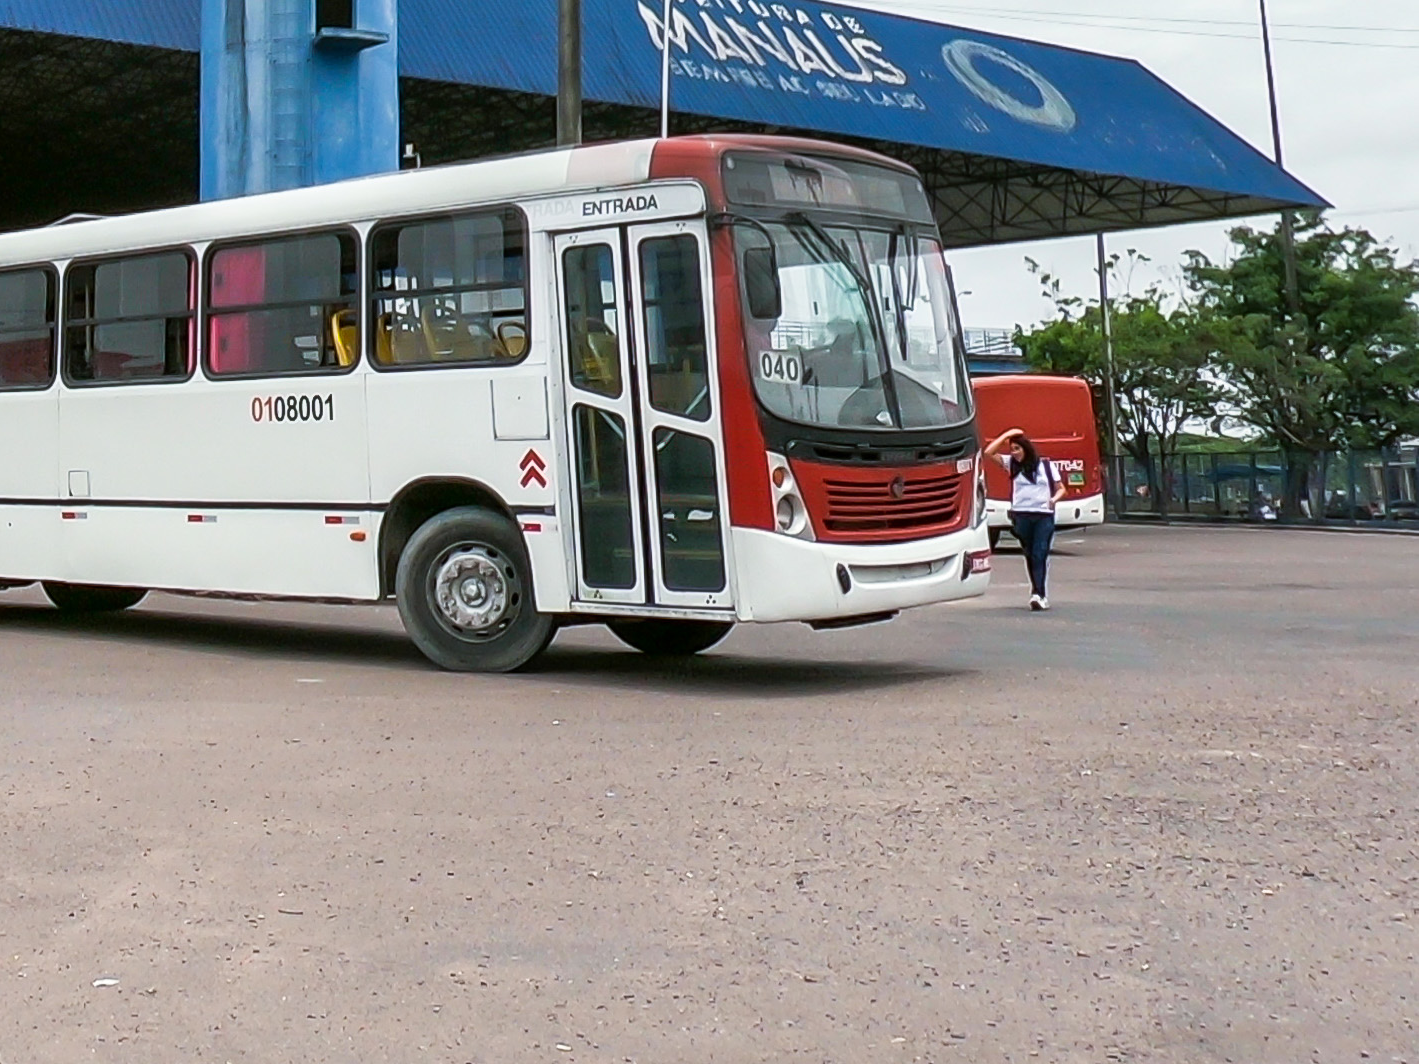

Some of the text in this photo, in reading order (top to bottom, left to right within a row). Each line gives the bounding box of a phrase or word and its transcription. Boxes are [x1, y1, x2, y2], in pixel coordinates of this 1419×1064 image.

[820, 11, 865, 35] DE
[637, 0, 907, 85] MANAUS
[582, 194, 658, 216] ENTRADA
[762, 353, 799, 382] 040
[251, 393, 334, 422] 0108001
